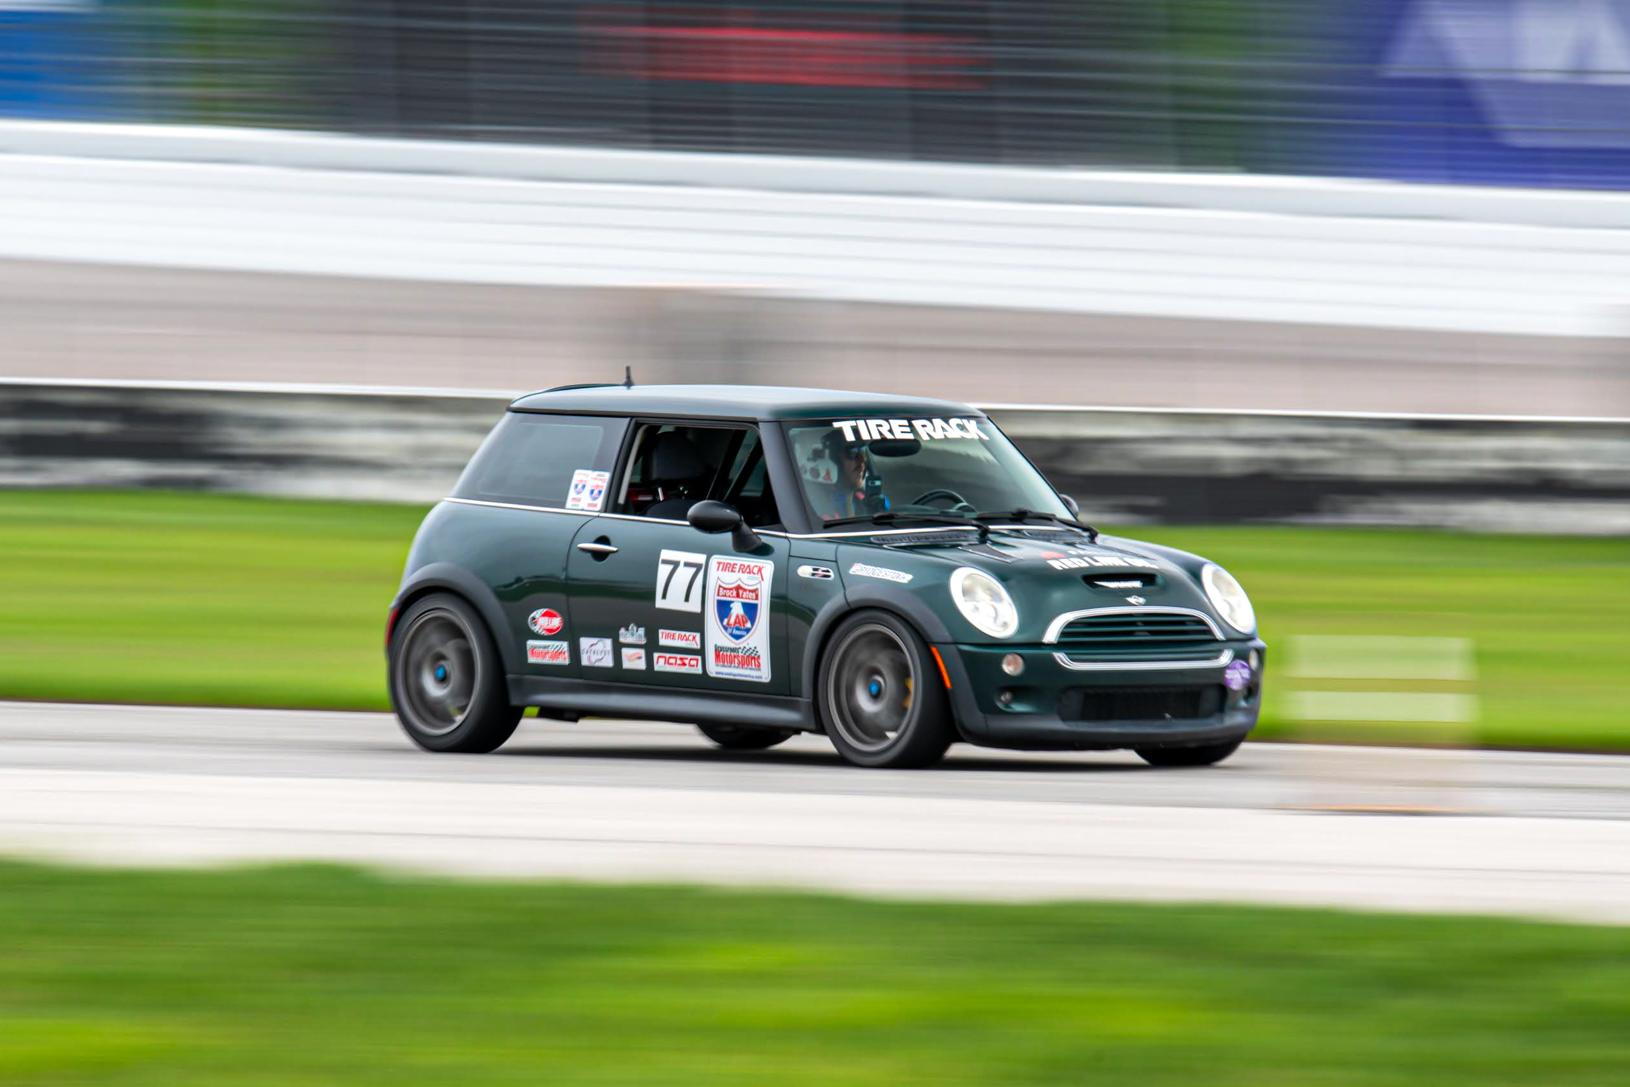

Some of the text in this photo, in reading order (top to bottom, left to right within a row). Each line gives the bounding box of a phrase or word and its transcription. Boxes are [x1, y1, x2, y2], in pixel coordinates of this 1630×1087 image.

[832, 418, 989, 442] TIRE RACK
[660, 558, 703, 602] 77
[716, 561, 765, 582] TIRE RACK
[719, 587, 737, 598] Brock
[726, 613, 749, 628] LAP
[660, 631, 699, 647] TIRE RACK
[714, 650, 761, 669] Motorsports
